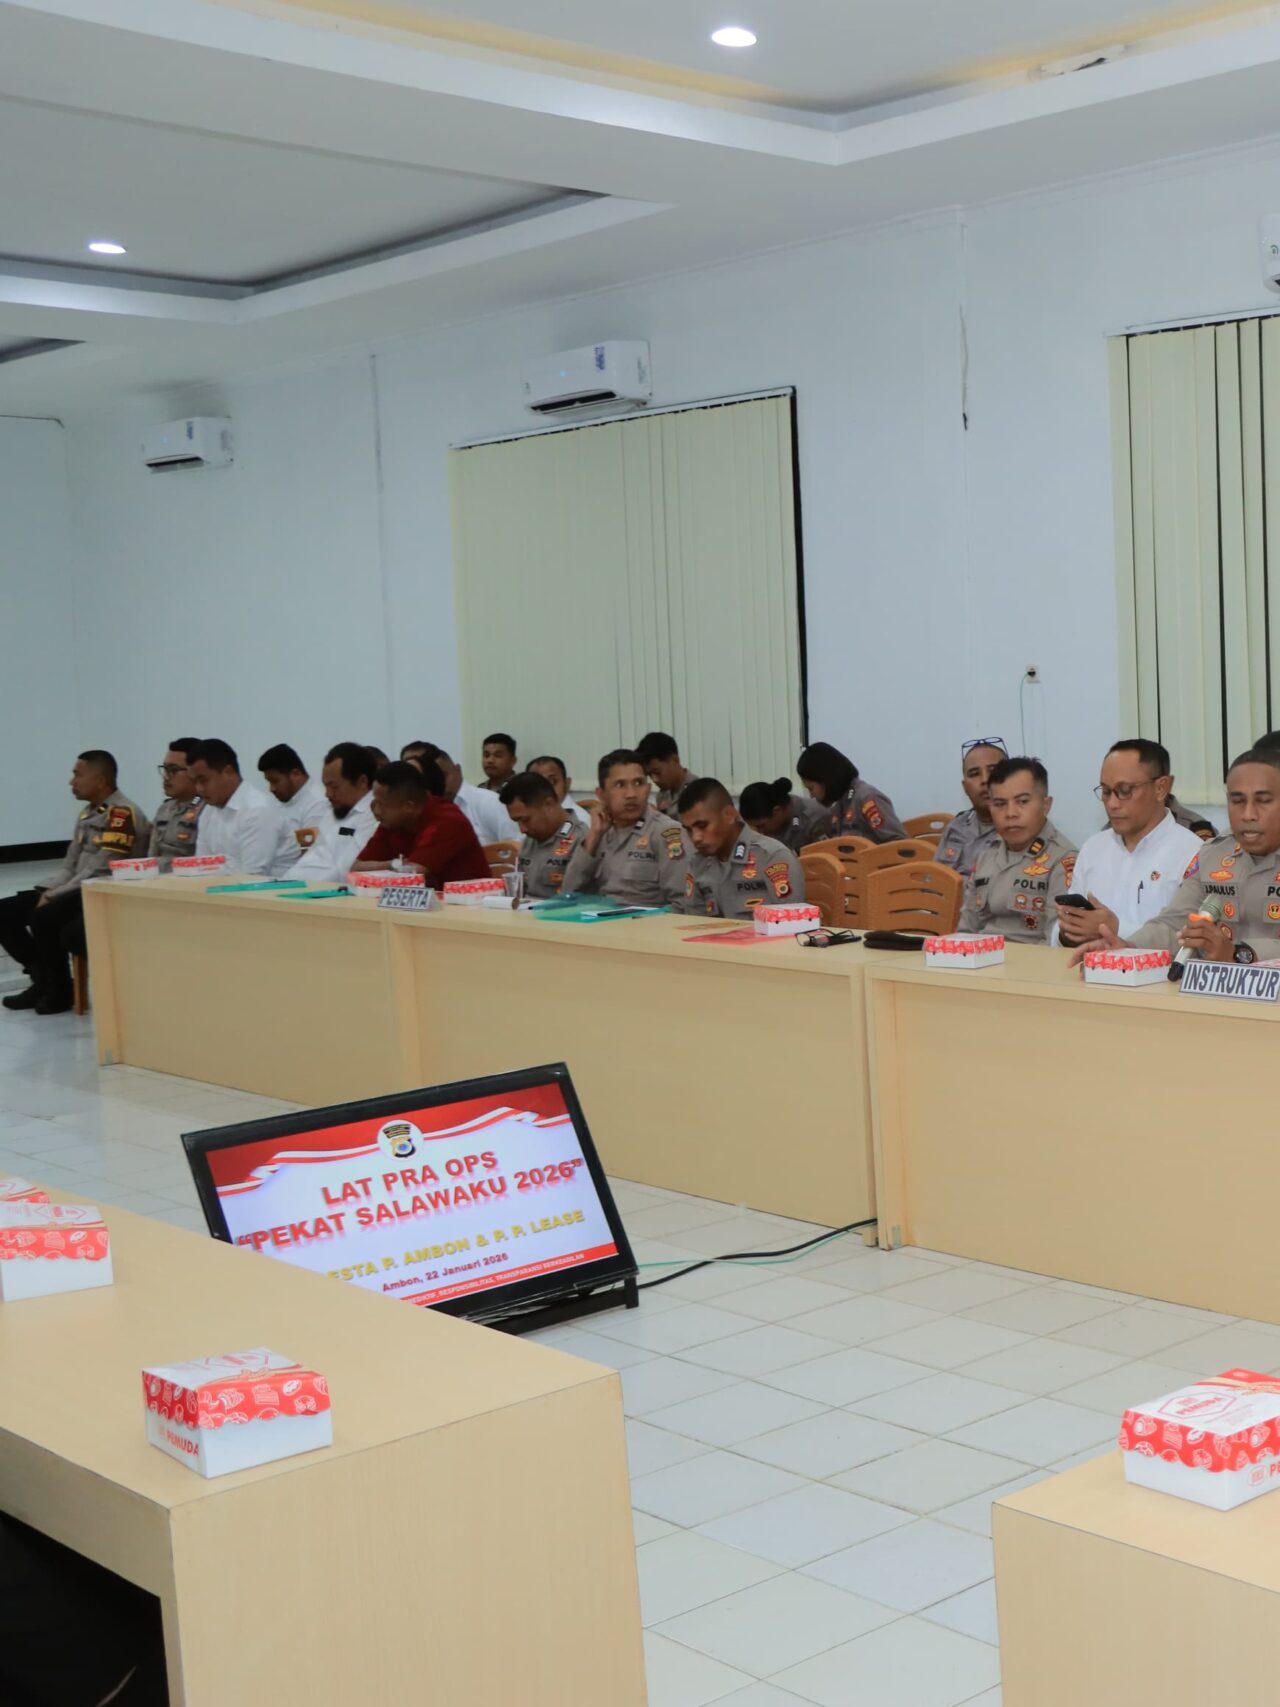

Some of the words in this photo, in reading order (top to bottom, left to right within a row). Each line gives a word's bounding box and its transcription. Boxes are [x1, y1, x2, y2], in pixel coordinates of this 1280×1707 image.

[380, 887, 430, 908] PESERTA
[1183, 963, 1280, 998] INSTRUKTUR
[321, 1176, 373, 1206] LAT
[382, 1164, 440, 1193] PRA
[445, 1151, 498, 1177] OPS
[355, 1175, 507, 1227] SALAWAKU
[382, 1256, 398, 1271] P.
[403, 1238, 471, 1265] AMBON
[476, 1233, 490, 1247] &
[493, 1229, 508, 1243] P.
[511, 1224, 526, 1238] P.
[529, 1209, 586, 1234] LEASE
[382, 1276, 424, 1293] Ambon,
[425, 1270, 439, 1281] 22
[441, 1260, 481, 1277] Januari
[483, 1252, 509, 1266] 2026
[166, 1429, 199, 1457] PEMUDA
